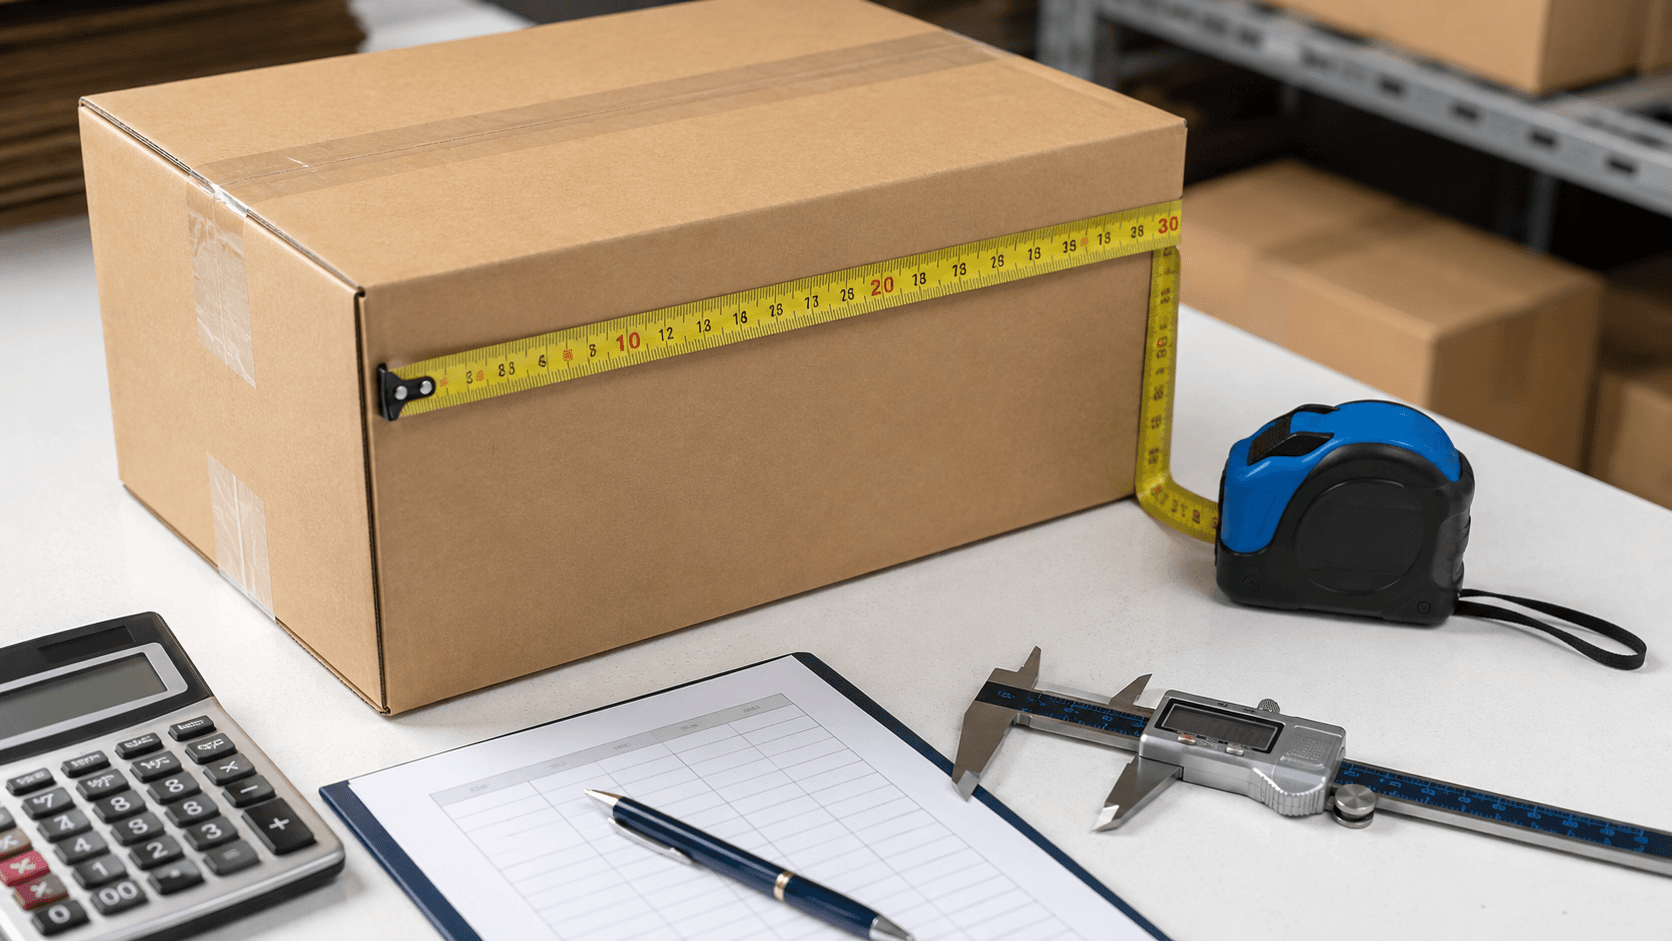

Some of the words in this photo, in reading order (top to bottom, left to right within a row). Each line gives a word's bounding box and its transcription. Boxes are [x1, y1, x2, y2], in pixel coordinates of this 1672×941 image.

[616, 332, 640, 352] 10
[658, 327, 674, 341] 12
[870, 276, 894, 296] 20
[1158, 216, 1179, 234] 30
[165, 778, 184, 793] 8
[110, 795, 131, 812] 8
[201, 823, 222, 840] 3
[74, 837, 91, 852] 4
[146, 841, 168, 859] 2
[92, 861, 108, 877] 1
[98, 881, 138, 906] 00
[48, 904, 71, 924] 0
